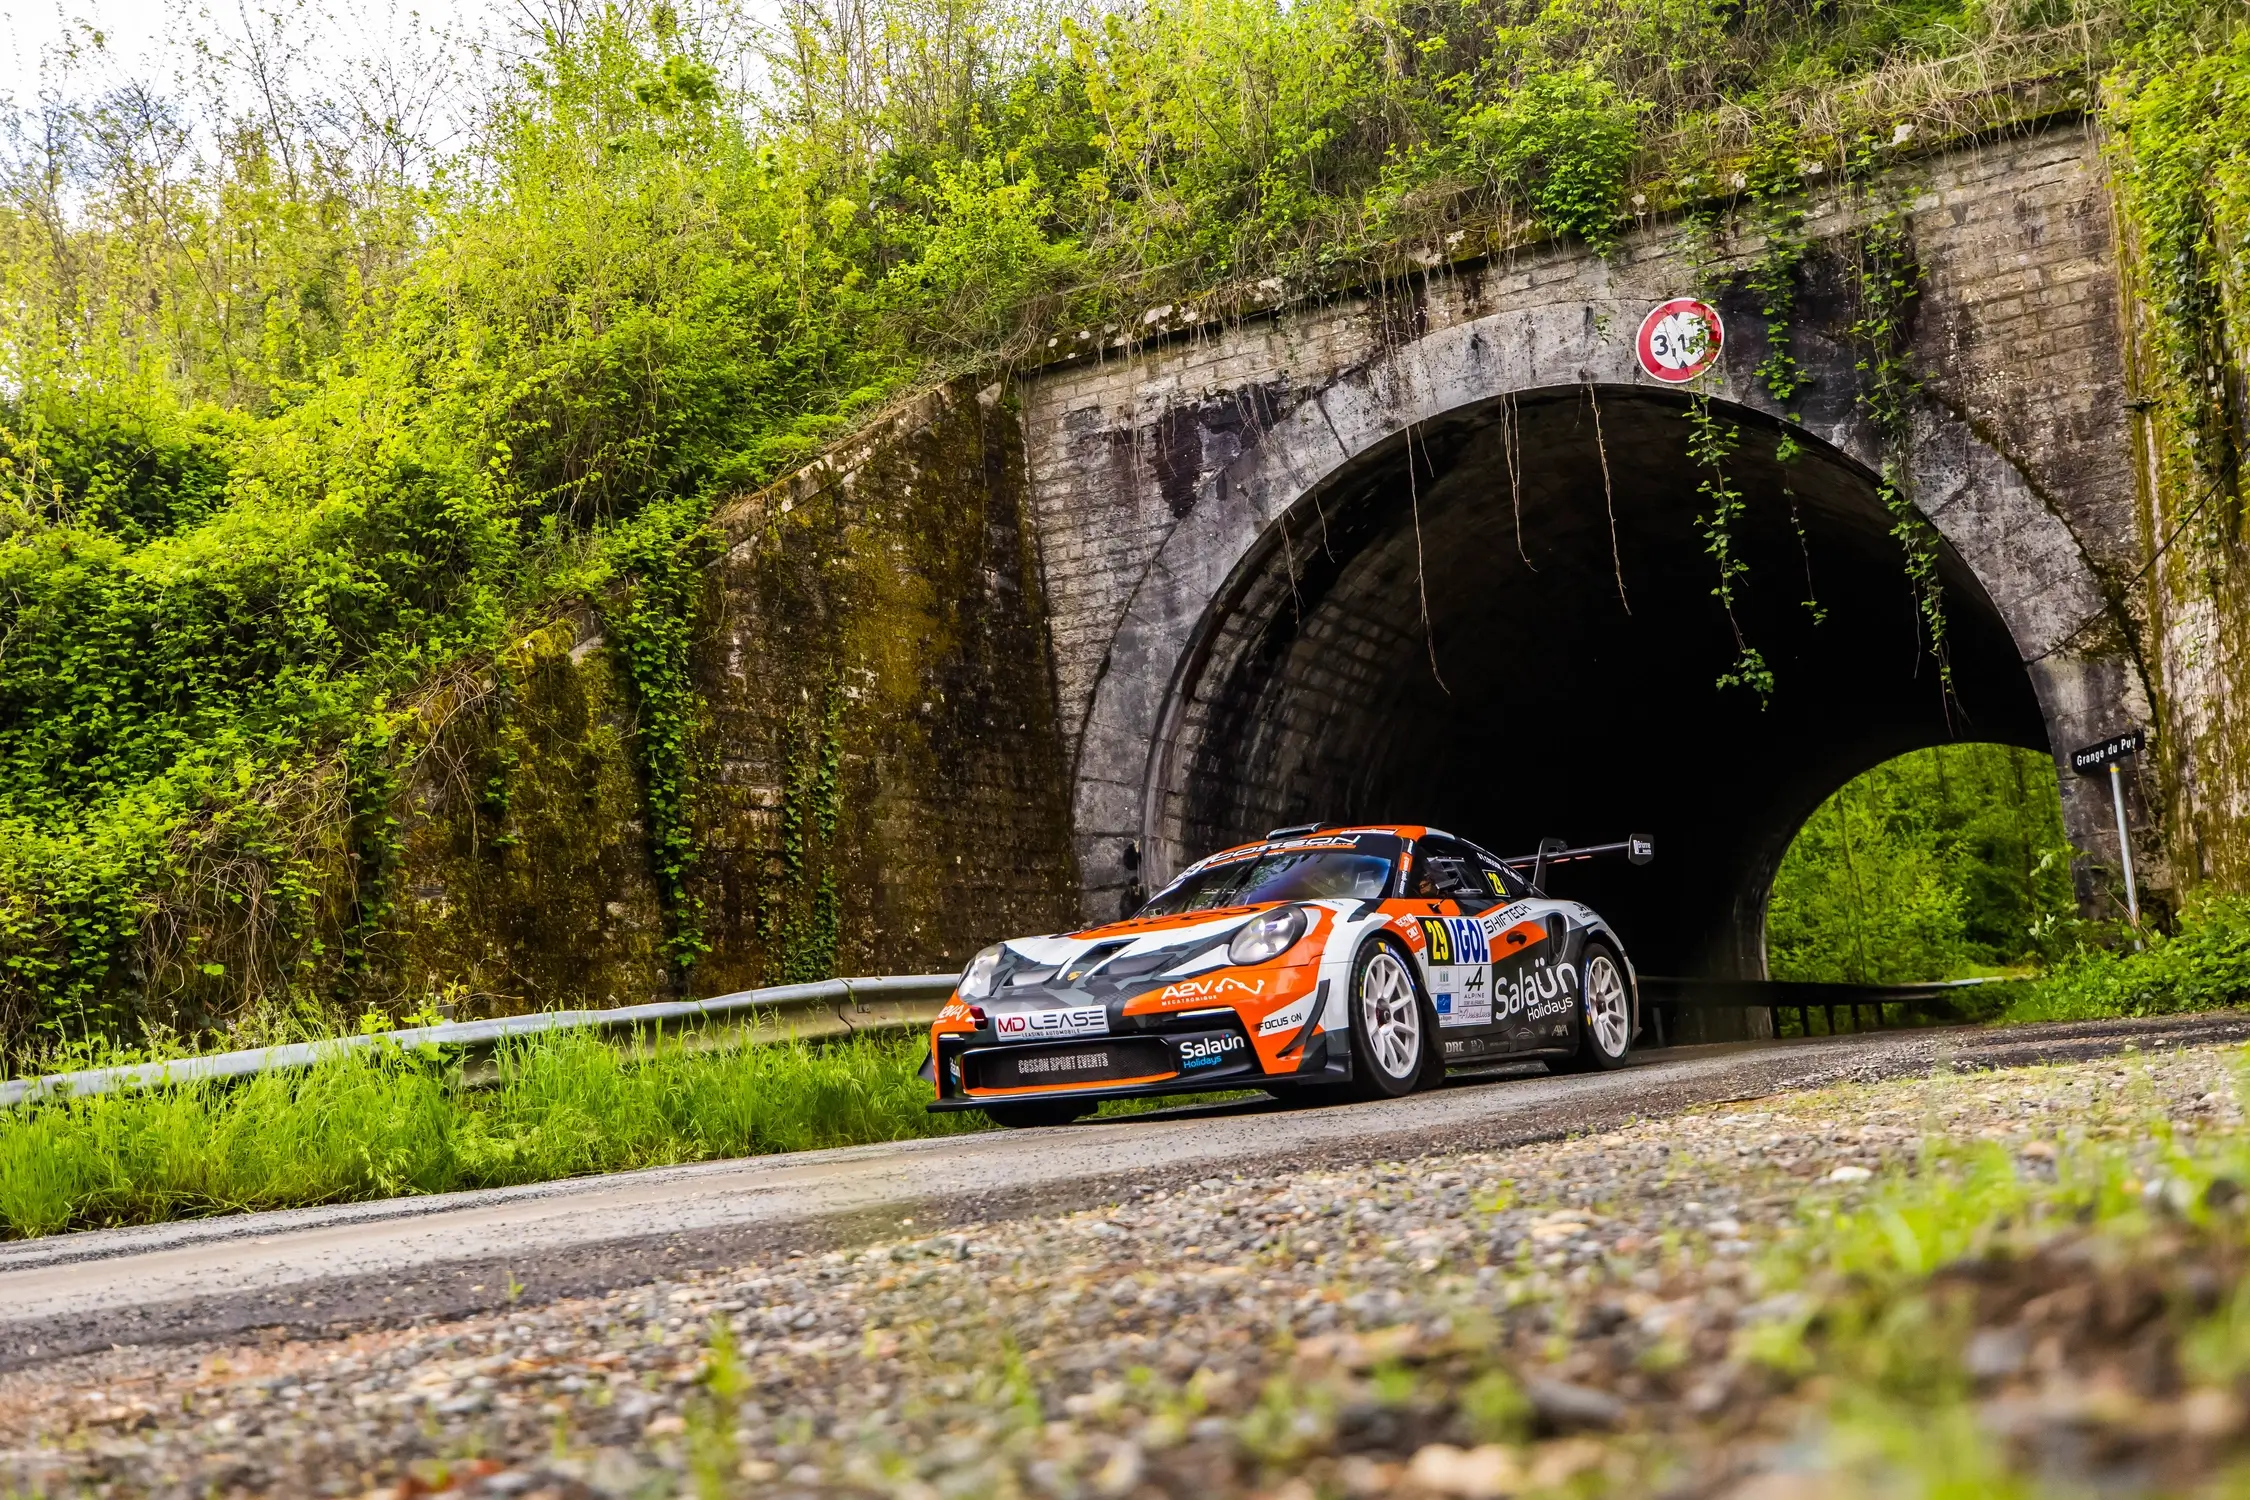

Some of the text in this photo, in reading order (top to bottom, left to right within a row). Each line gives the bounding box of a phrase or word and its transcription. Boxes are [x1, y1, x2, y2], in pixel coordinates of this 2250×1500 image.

[2077, 737, 2136, 767] Grange du Puy
[1484, 903, 1532, 934] SHIFTECH
[1425, 920, 1449, 960] 29
[1449, 919, 1488, 963] IGOL
[1161, 980, 1213, 999] A2V
[1495, 957, 1579, 1020] Salaün
[1161, 995, 1217, 1006] MECATRONIQUE
[1526, 996, 1574, 1021] Holidays
[998, 1010, 1105, 1032] MD LEASE
[1045, 1028, 1081, 1036] AUTOMOBILE
[1257, 1012, 1303, 1031] FOCUS ON
[1179, 1033, 1245, 1060] Salaün
[1050, 1055, 1077, 1071] SPORT
[1076, 1052, 1109, 1069] EVENTS
[1183, 1055, 1222, 1069] Holidays
